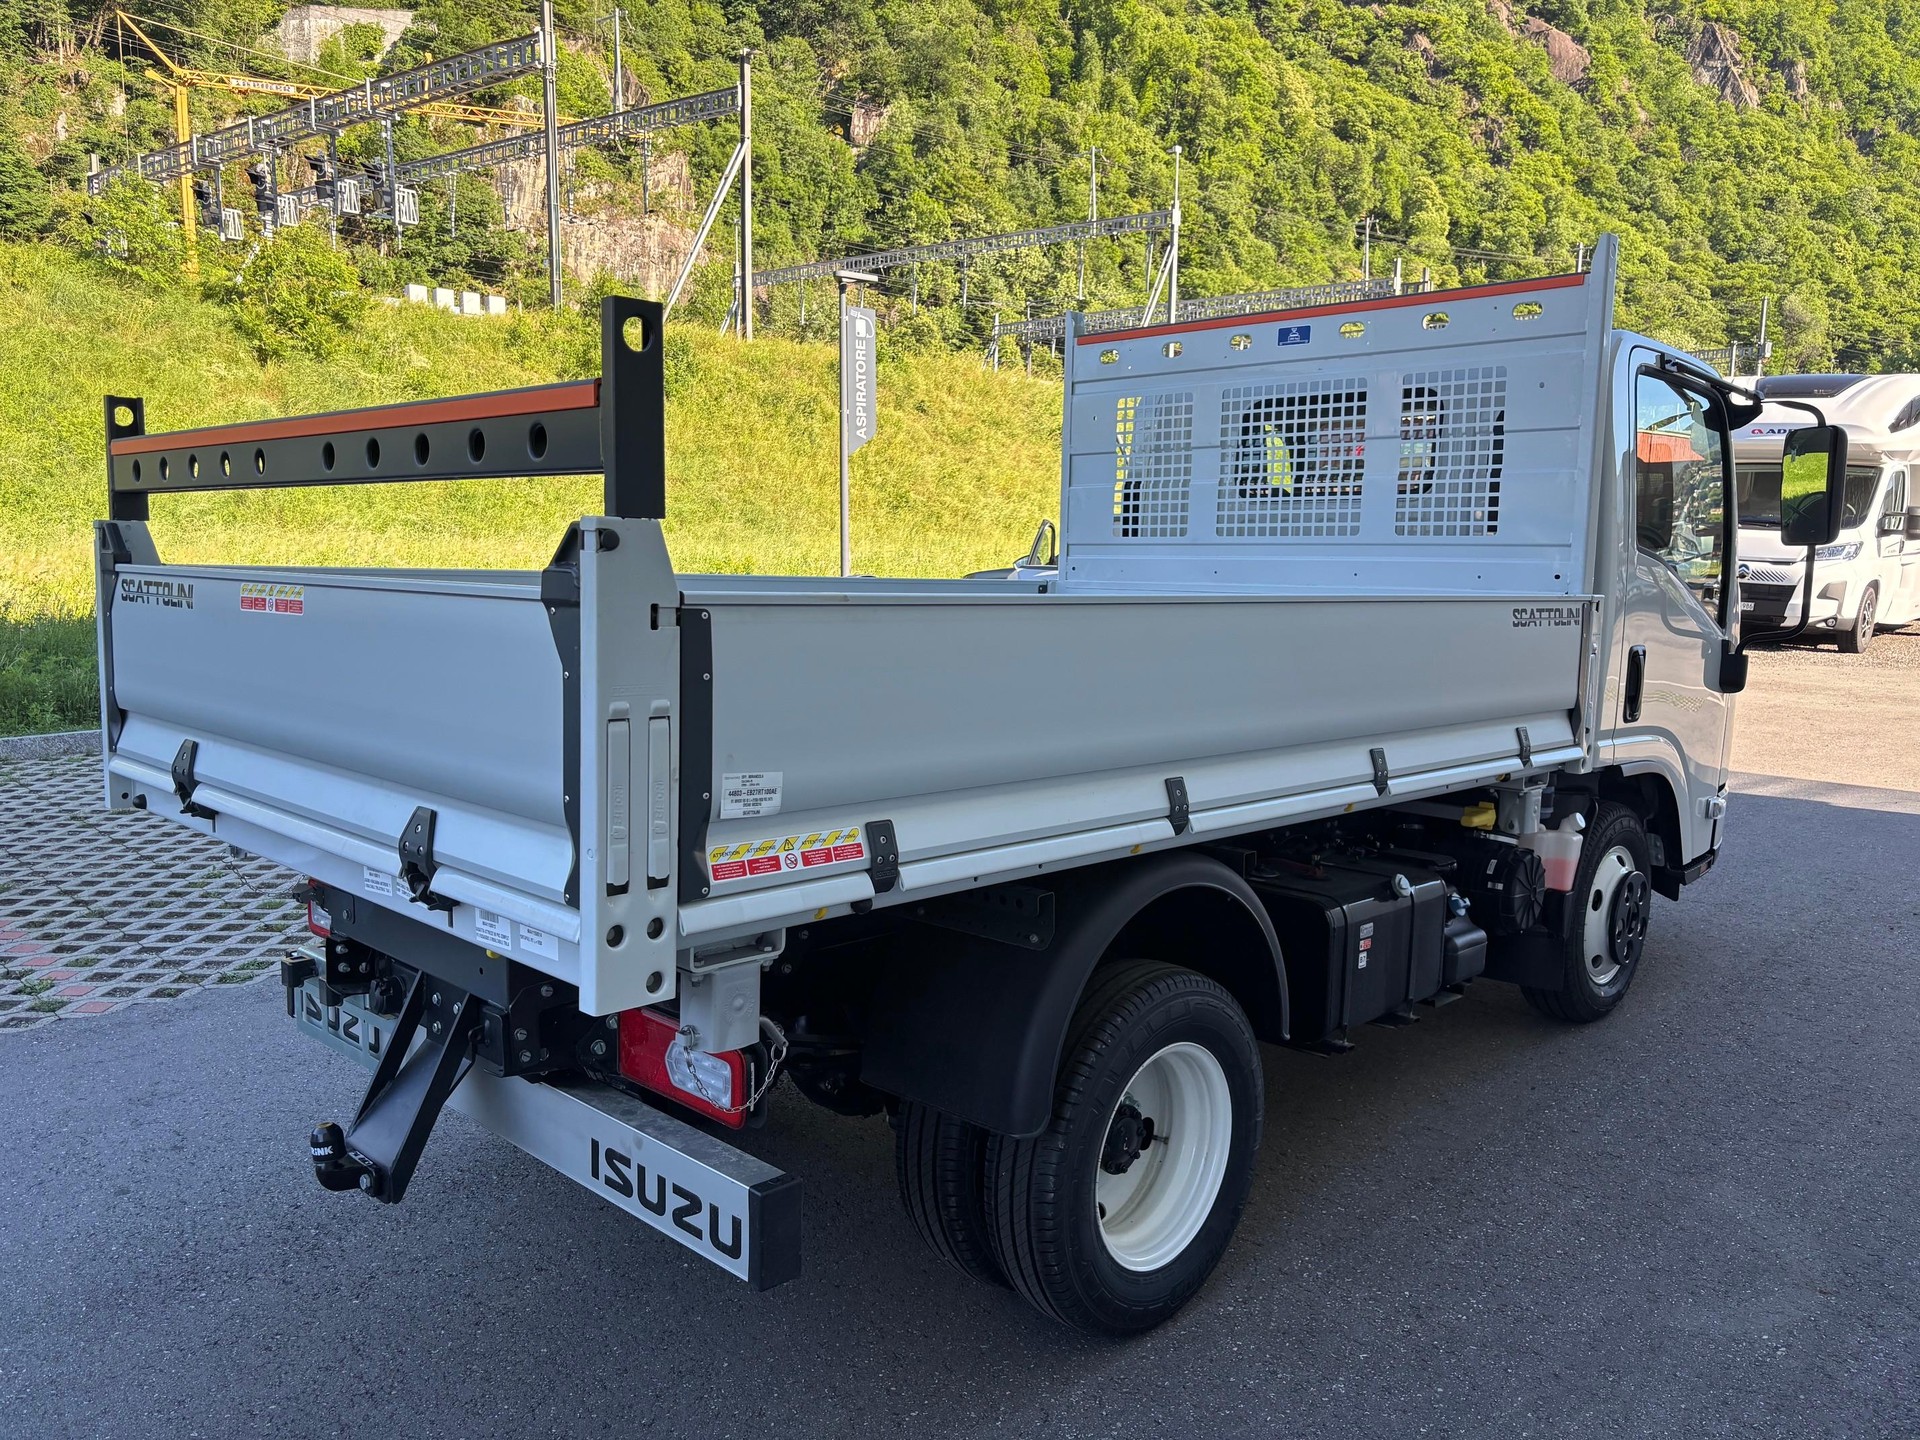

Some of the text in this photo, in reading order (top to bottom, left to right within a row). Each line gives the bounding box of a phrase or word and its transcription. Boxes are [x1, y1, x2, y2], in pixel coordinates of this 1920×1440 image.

[856, 340, 867, 439] ASPIRATORE
[121, 578, 194, 609] SCATTOLINI
[1512, 608, 1580, 627] SCATTOLINI
[712, 850, 741, 858] ATTENTION
[591, 1137, 742, 1260] ISUZU
